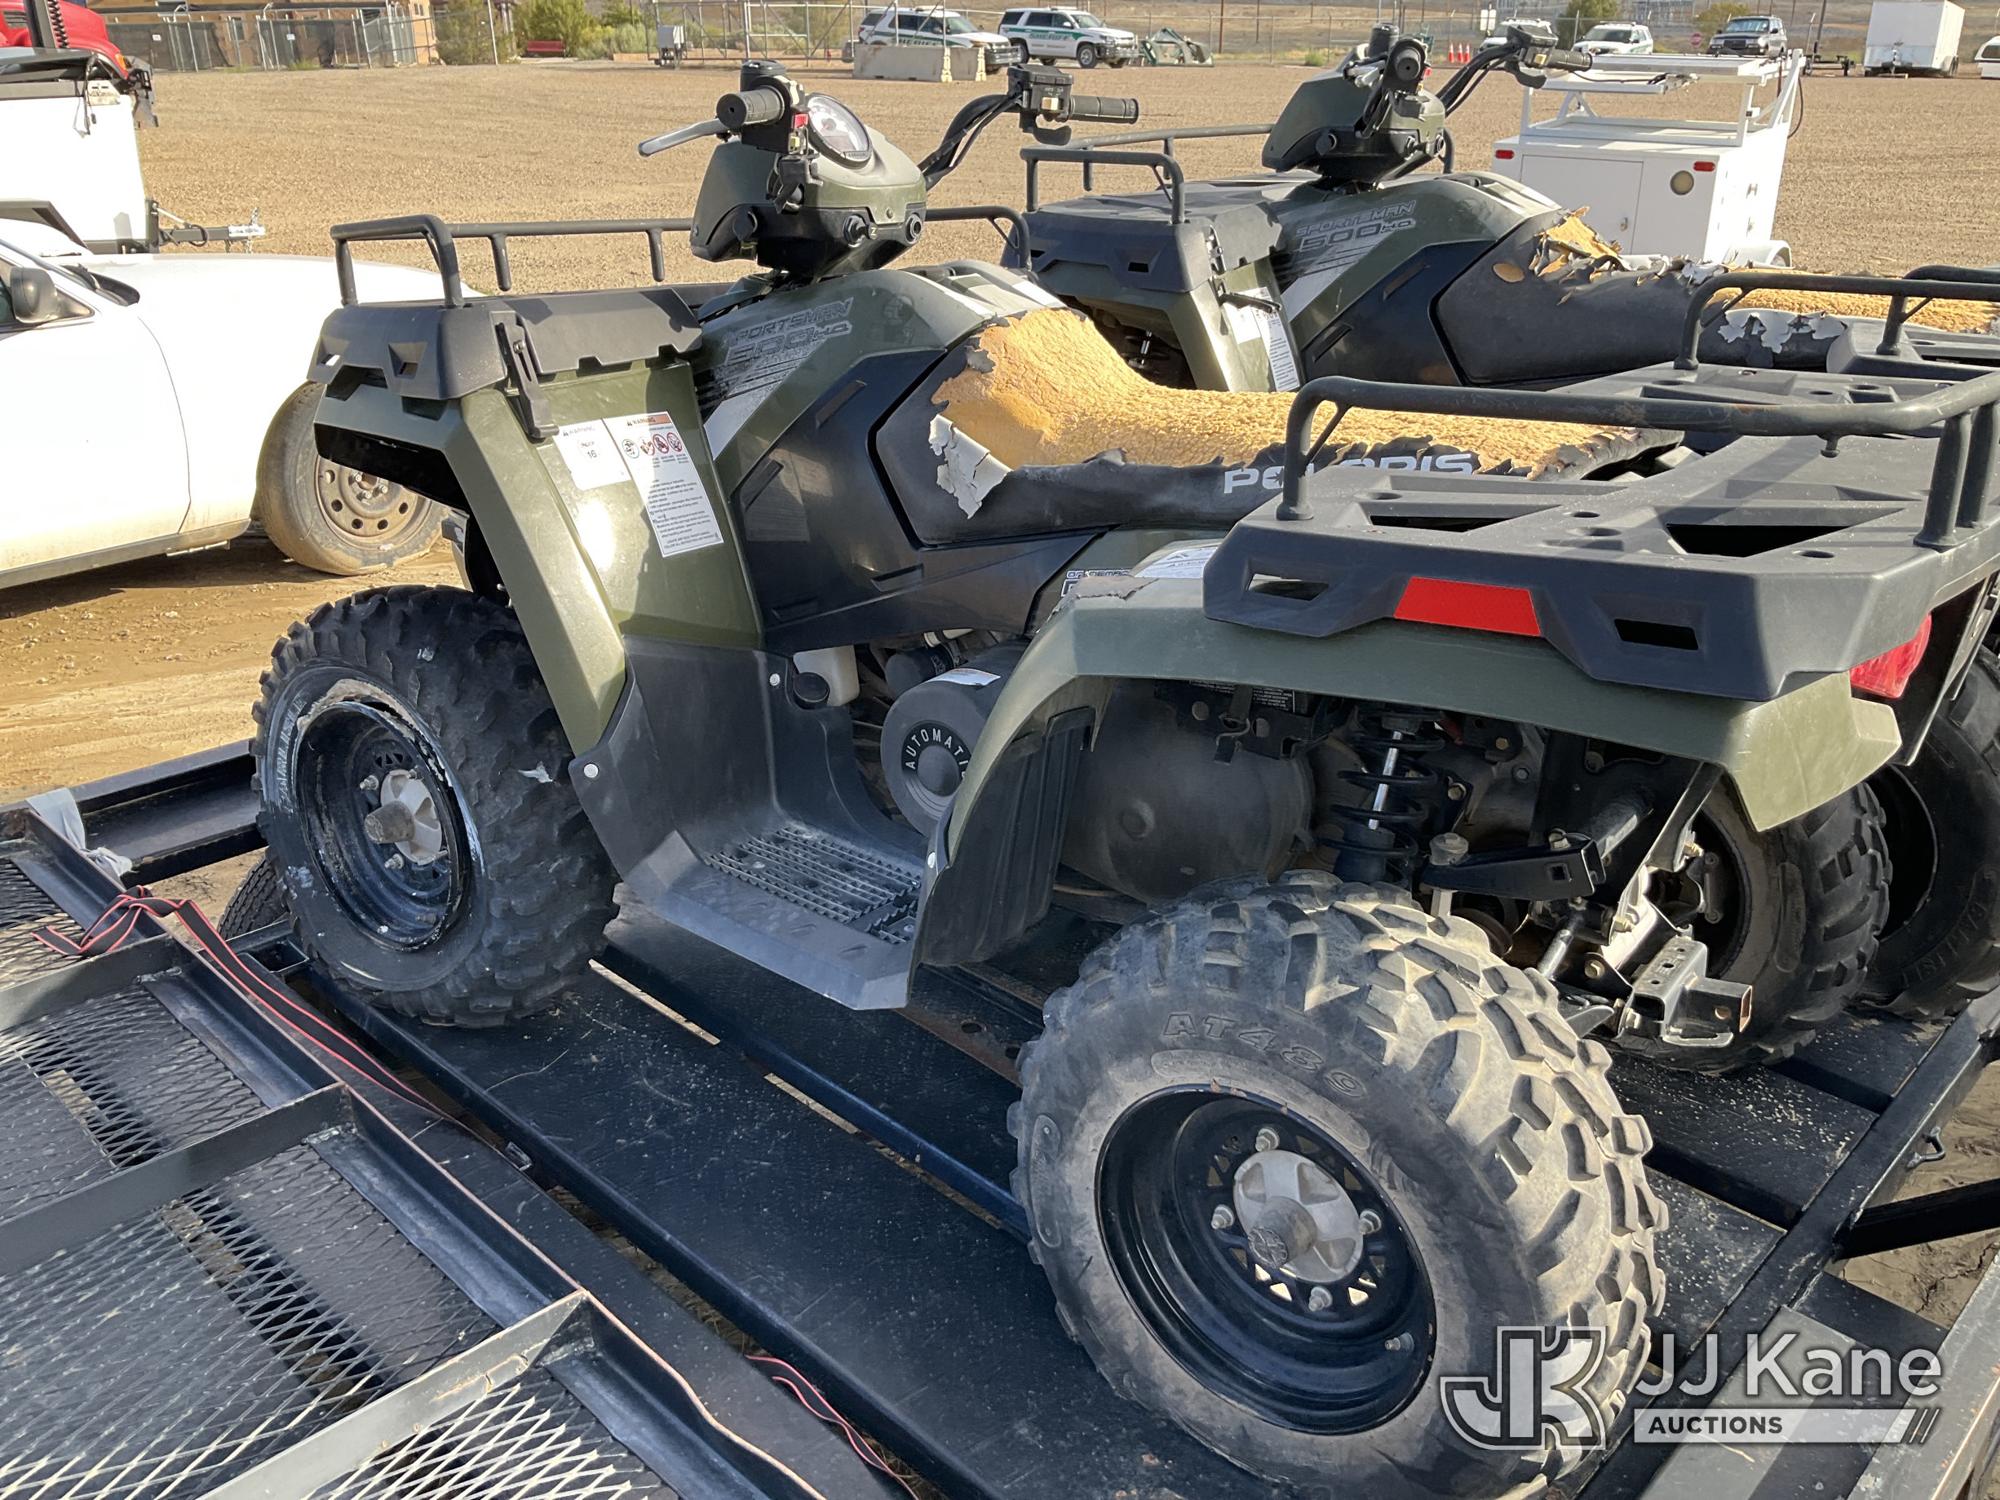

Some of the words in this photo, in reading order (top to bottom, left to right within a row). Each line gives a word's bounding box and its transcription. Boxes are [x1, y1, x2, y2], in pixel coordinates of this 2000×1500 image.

[1296, 200, 1415, 238] SPORTSMAN
[1301, 223, 1380, 249] 500
[726, 297, 852, 344] PORTSMAN
[1224, 453, 1473, 494] POARIS
